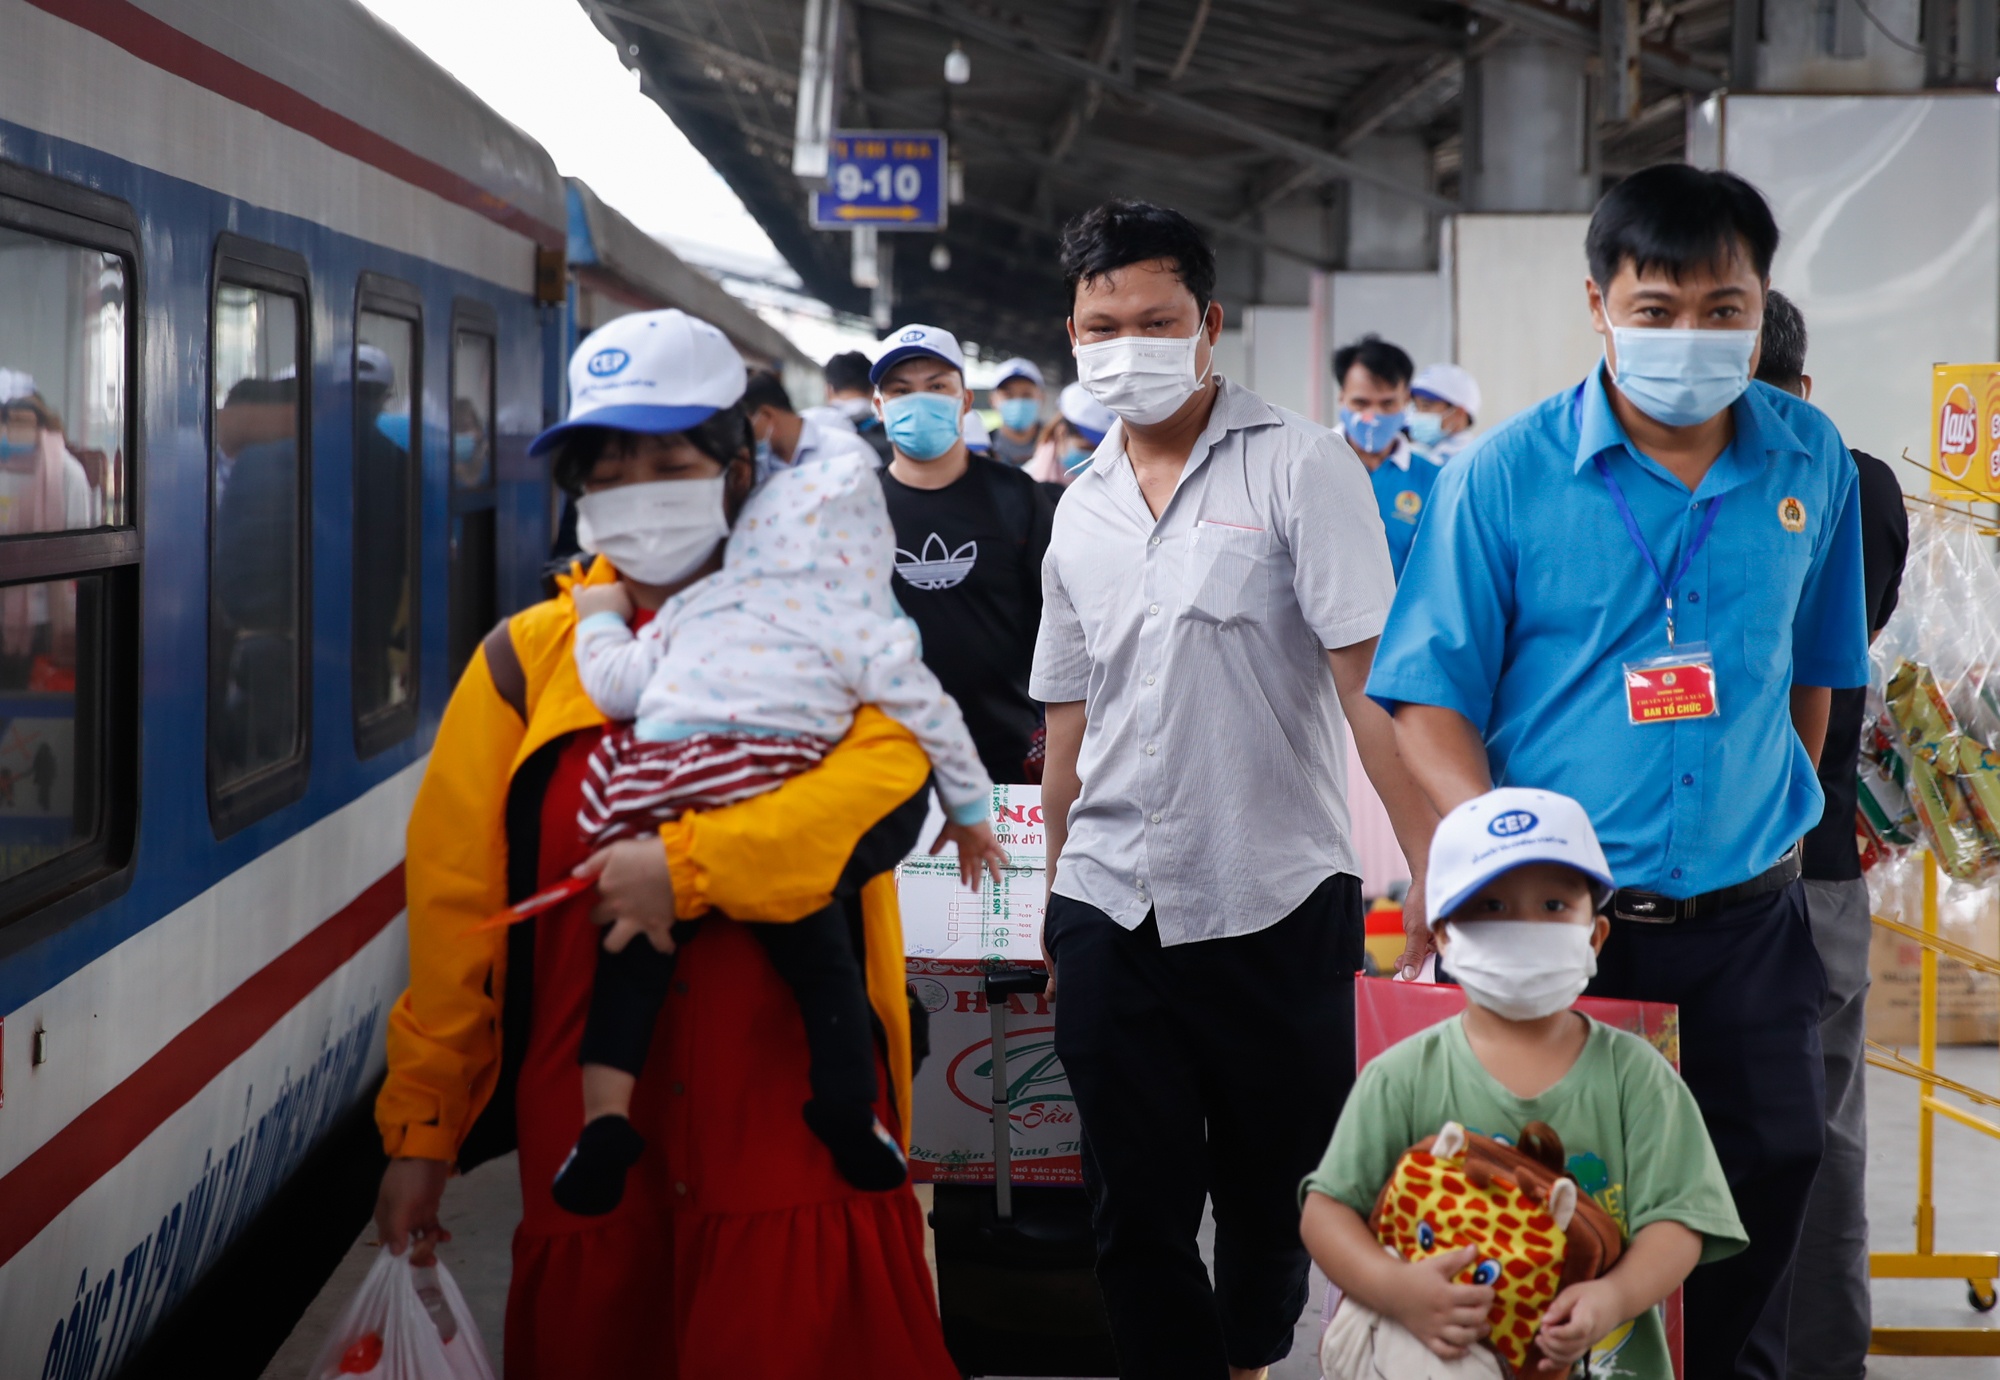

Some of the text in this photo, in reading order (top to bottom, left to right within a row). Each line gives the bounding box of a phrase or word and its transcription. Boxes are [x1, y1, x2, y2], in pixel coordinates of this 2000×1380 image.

[836, 163, 922, 201] 9-10
[1643, 706, 1661, 717] BAN
[1492, 813, 1532, 834] CEP
[1021, 832, 1043, 845] LẠP
[1022, 1102, 1074, 1129] Sầu
